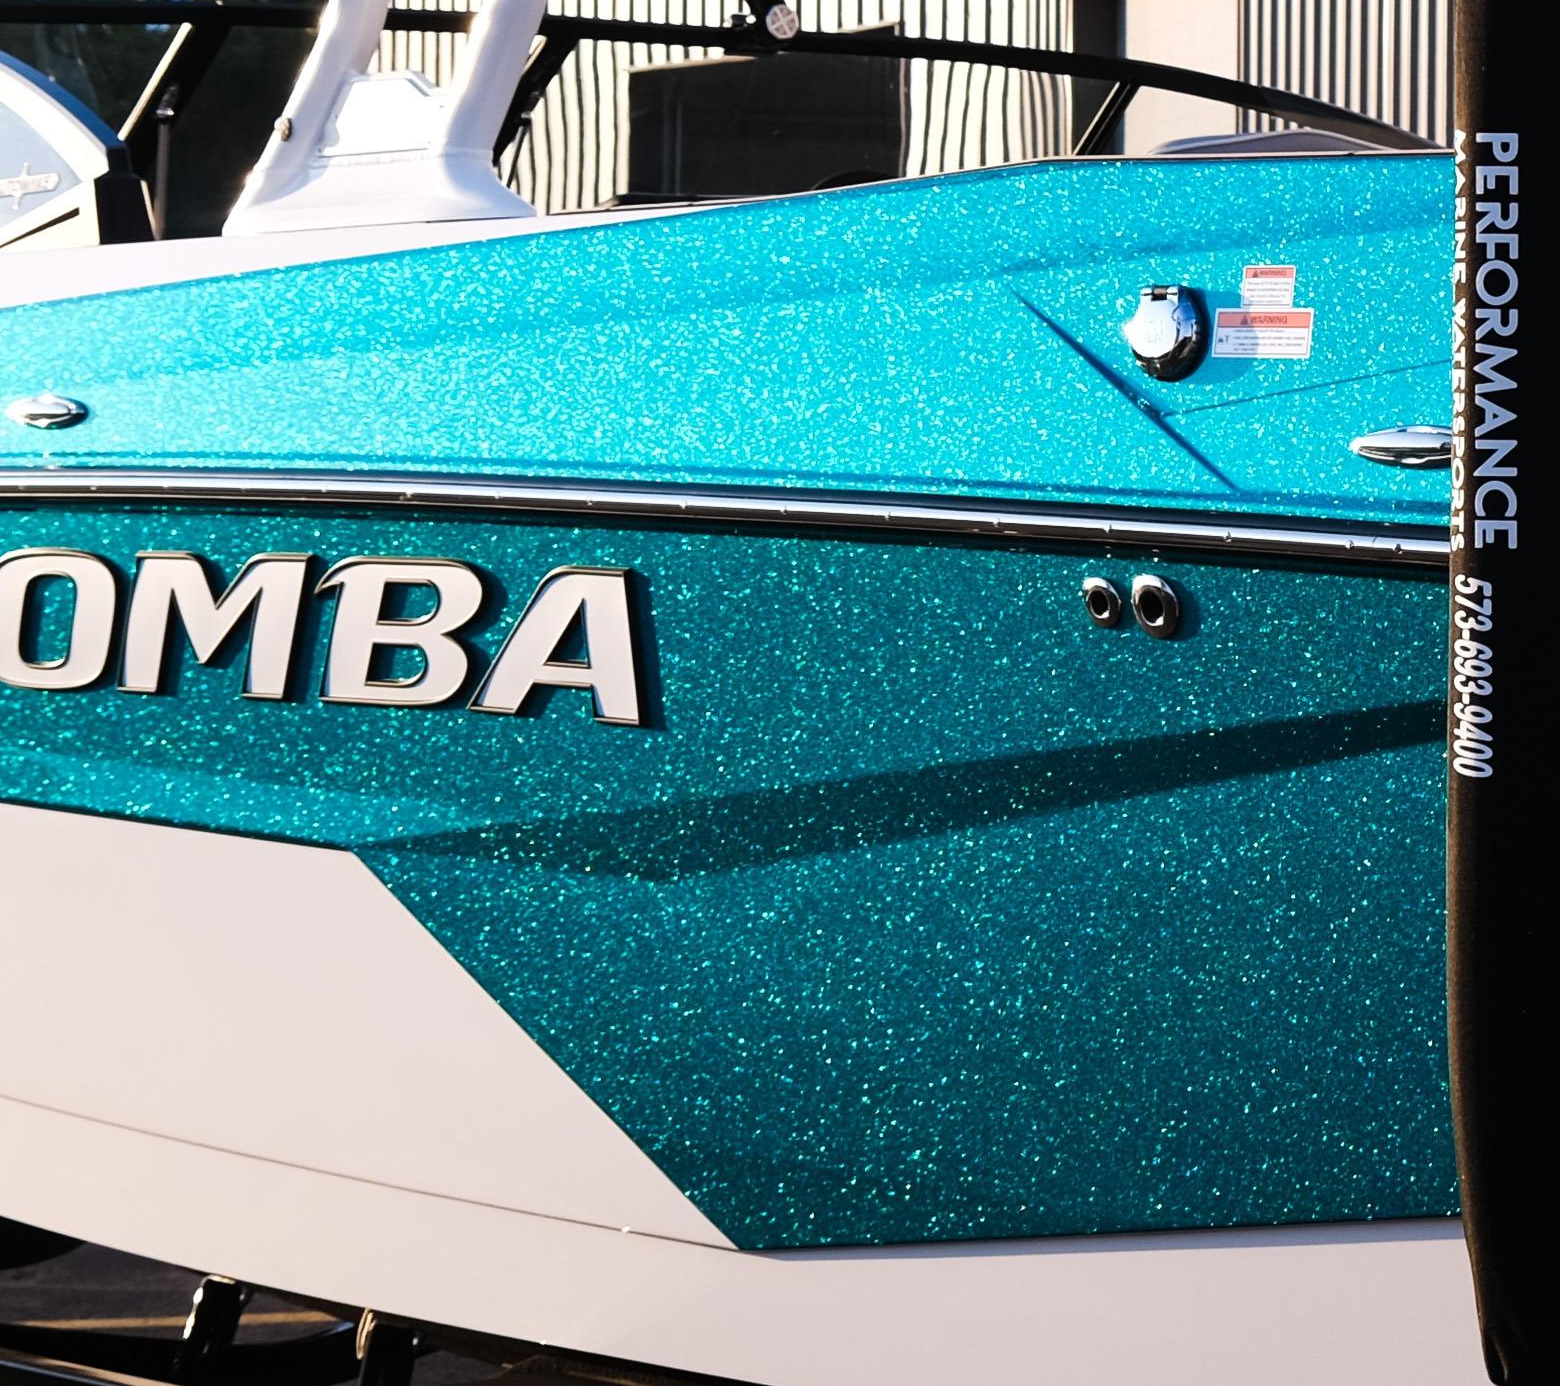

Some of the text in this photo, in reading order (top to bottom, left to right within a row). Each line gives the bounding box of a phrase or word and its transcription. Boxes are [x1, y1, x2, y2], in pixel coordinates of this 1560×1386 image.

[1250, 316, 1288, 324] WARNING
[1473, 132, 1519, 549] PERFORMANCE
[1453, 574, 1493, 778] 573-693-9400
